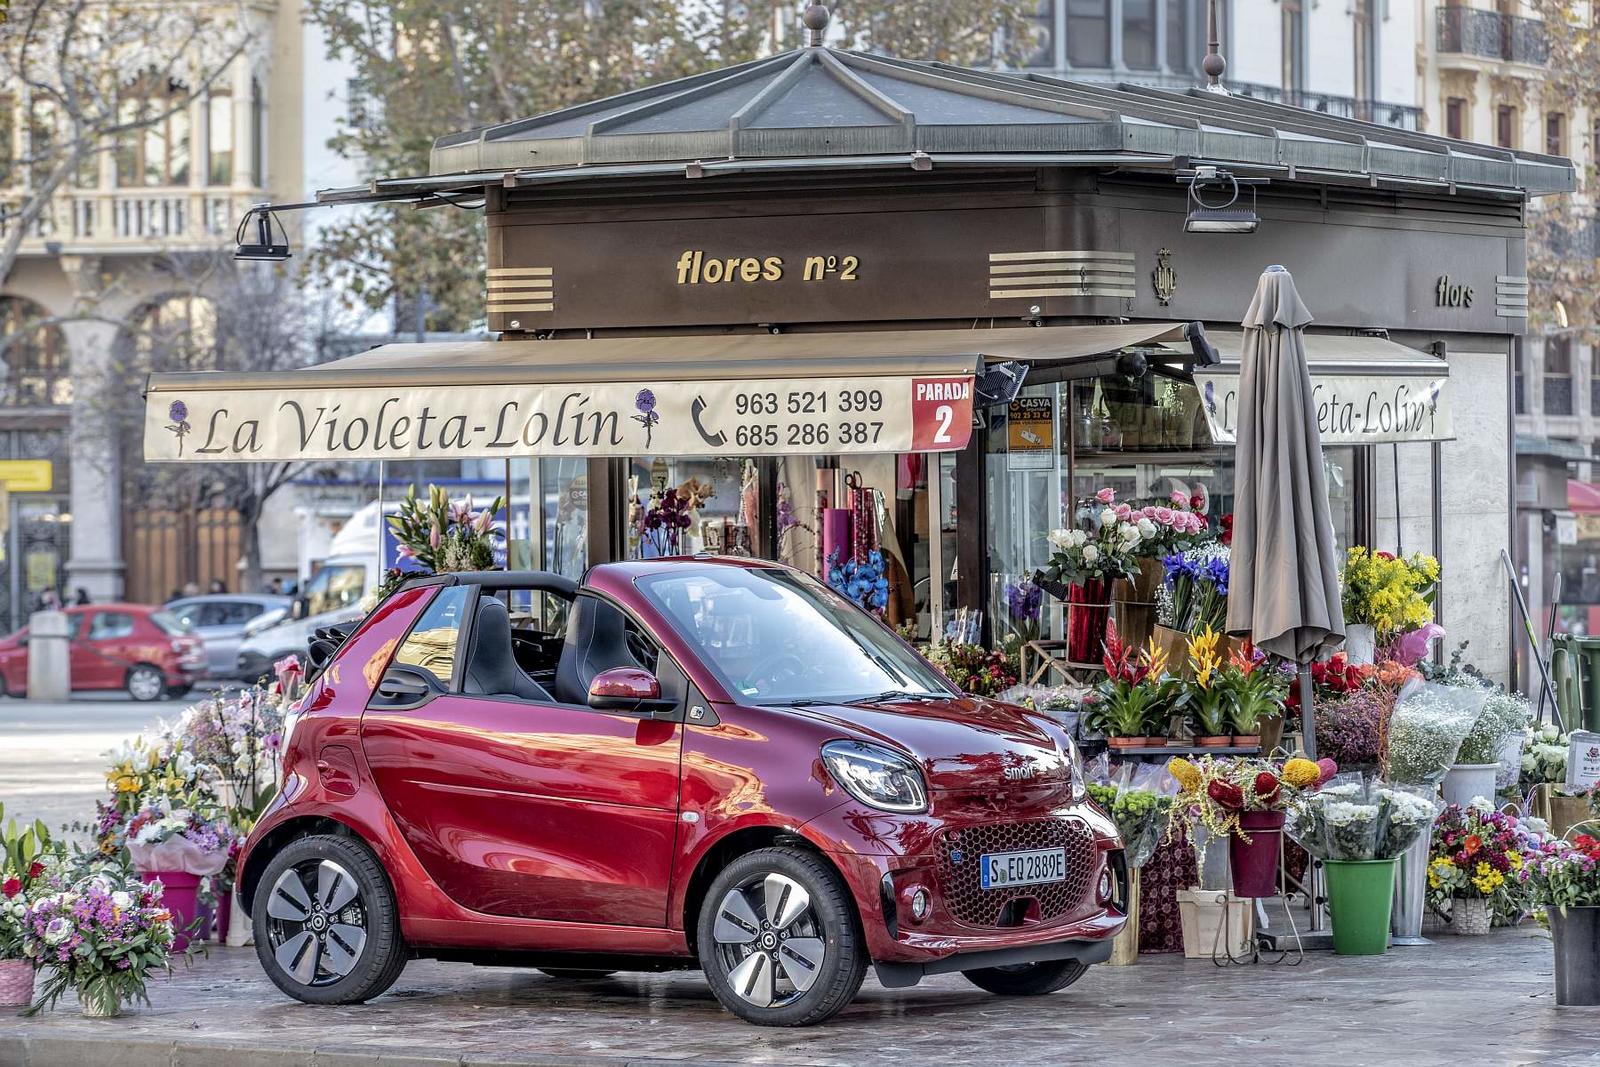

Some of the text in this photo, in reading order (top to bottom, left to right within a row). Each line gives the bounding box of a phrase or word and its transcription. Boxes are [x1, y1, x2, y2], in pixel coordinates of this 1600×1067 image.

[676, 250, 784, 285] flores
[1435, 274, 1474, 308] flors
[735, 389, 884, 415] 963 521 399
[916, 382, 970, 401] PARADA
[1020, 398, 1051, 408] CASVA
[194, 391, 625, 454] La Violeta-Lolín
[933, 404, 953, 444] 2
[1223, 384, 1426, 434] L eta-Lolín
[735, 421, 884, 447] 685 286 387
[990, 859, 999, 883] S
